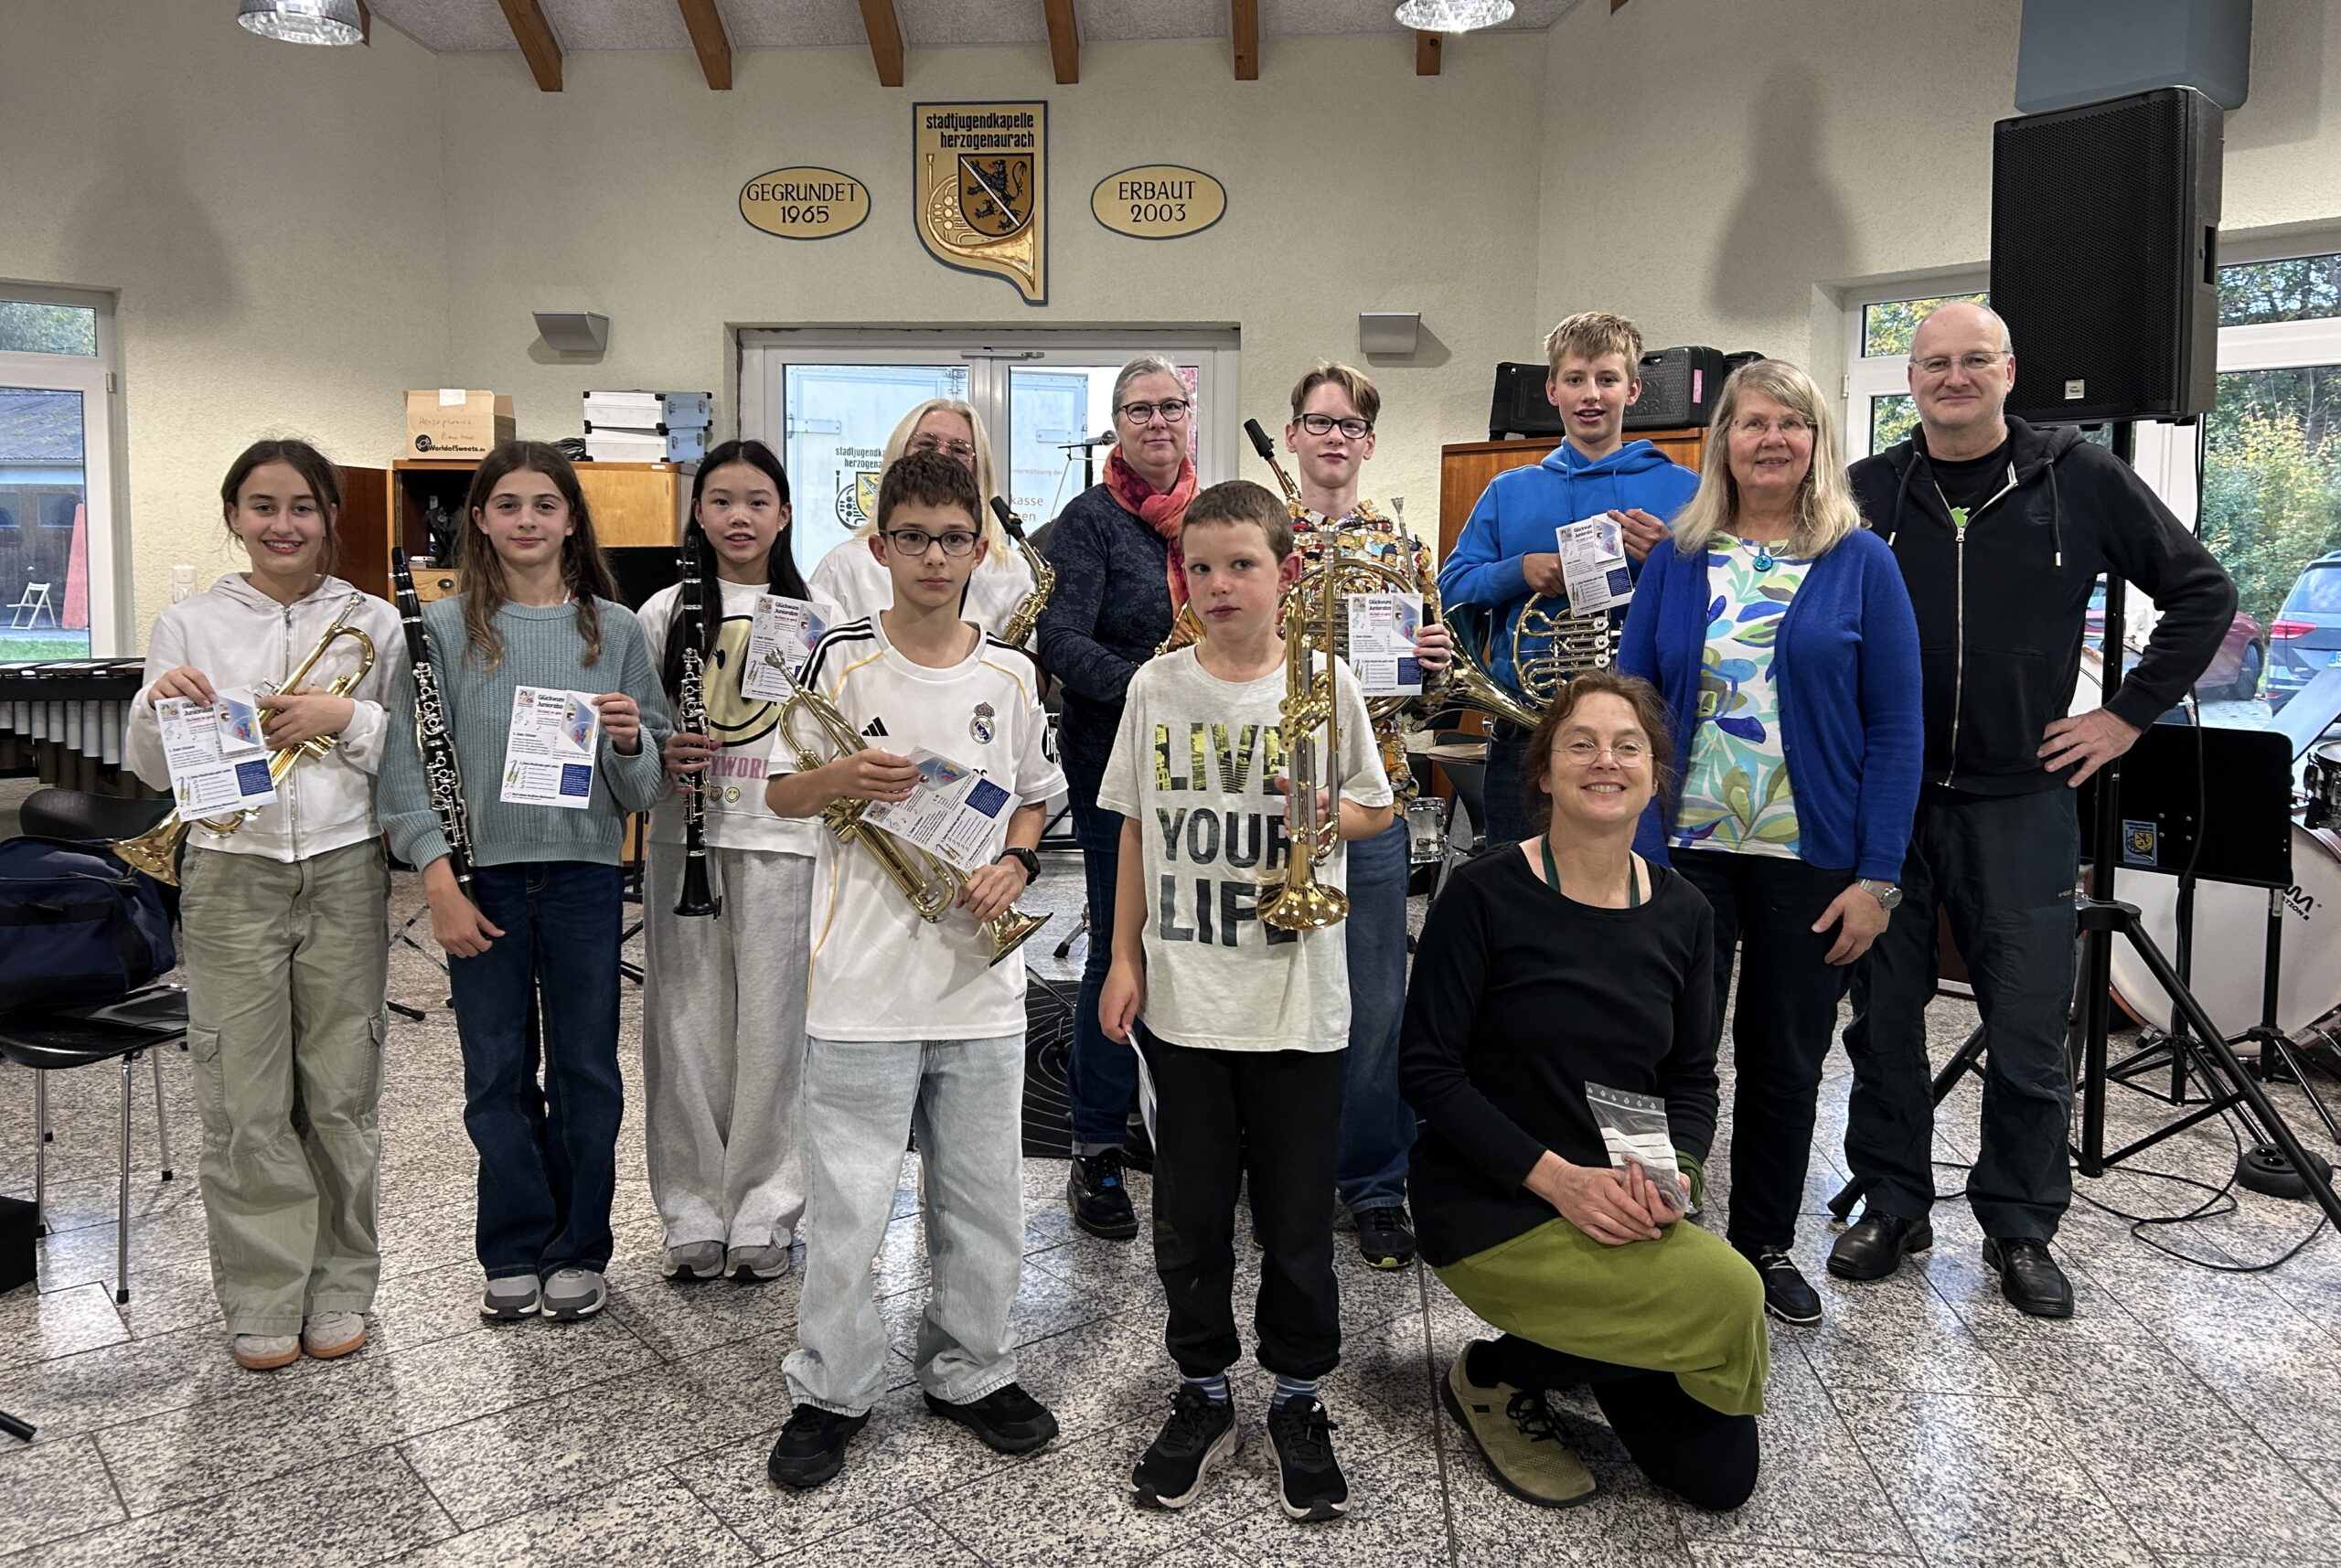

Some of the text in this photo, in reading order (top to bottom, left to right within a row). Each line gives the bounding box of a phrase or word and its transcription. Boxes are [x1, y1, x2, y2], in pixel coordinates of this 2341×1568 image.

[925, 112, 1034, 132] stadtjugendkapelle
[940, 132, 1035, 151] herzogenaurach
[746, 183, 858, 202] GEGRÜNDET
[1118, 181, 1196, 200] ERBAUT
[780, 206, 829, 223] 1965
[1130, 204, 1186, 222] 2003
[428, 444, 486, 453] WorldofSweets.de
[844, 458, 882, 470] herzogena
[1009, 495, 1044, 507] kasse
[711, 755, 769, 780] YWORL
[1155, 722, 1289, 795] LIVE
[1156, 807, 1291, 870] YOUR
